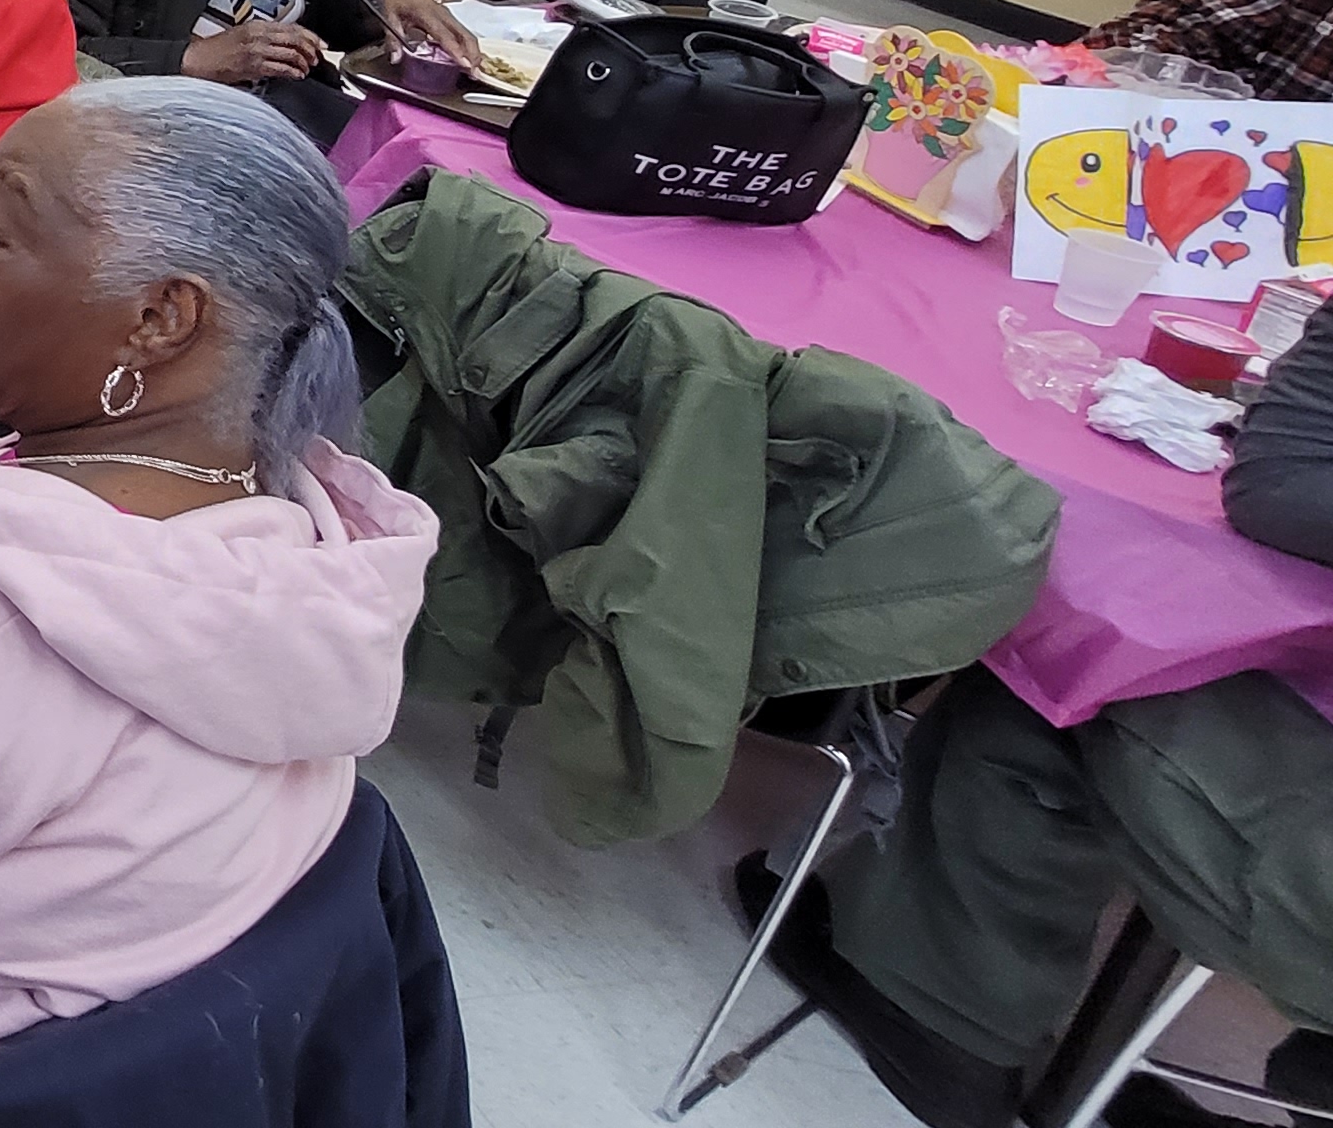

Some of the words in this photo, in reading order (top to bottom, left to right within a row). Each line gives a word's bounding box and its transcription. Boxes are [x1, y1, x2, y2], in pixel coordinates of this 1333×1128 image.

[712, 145, 788, 170] THE
[634, 153, 737, 188] TOTE
[744, 170, 818, 196] BAG
[659, 187, 707, 198] MARC
